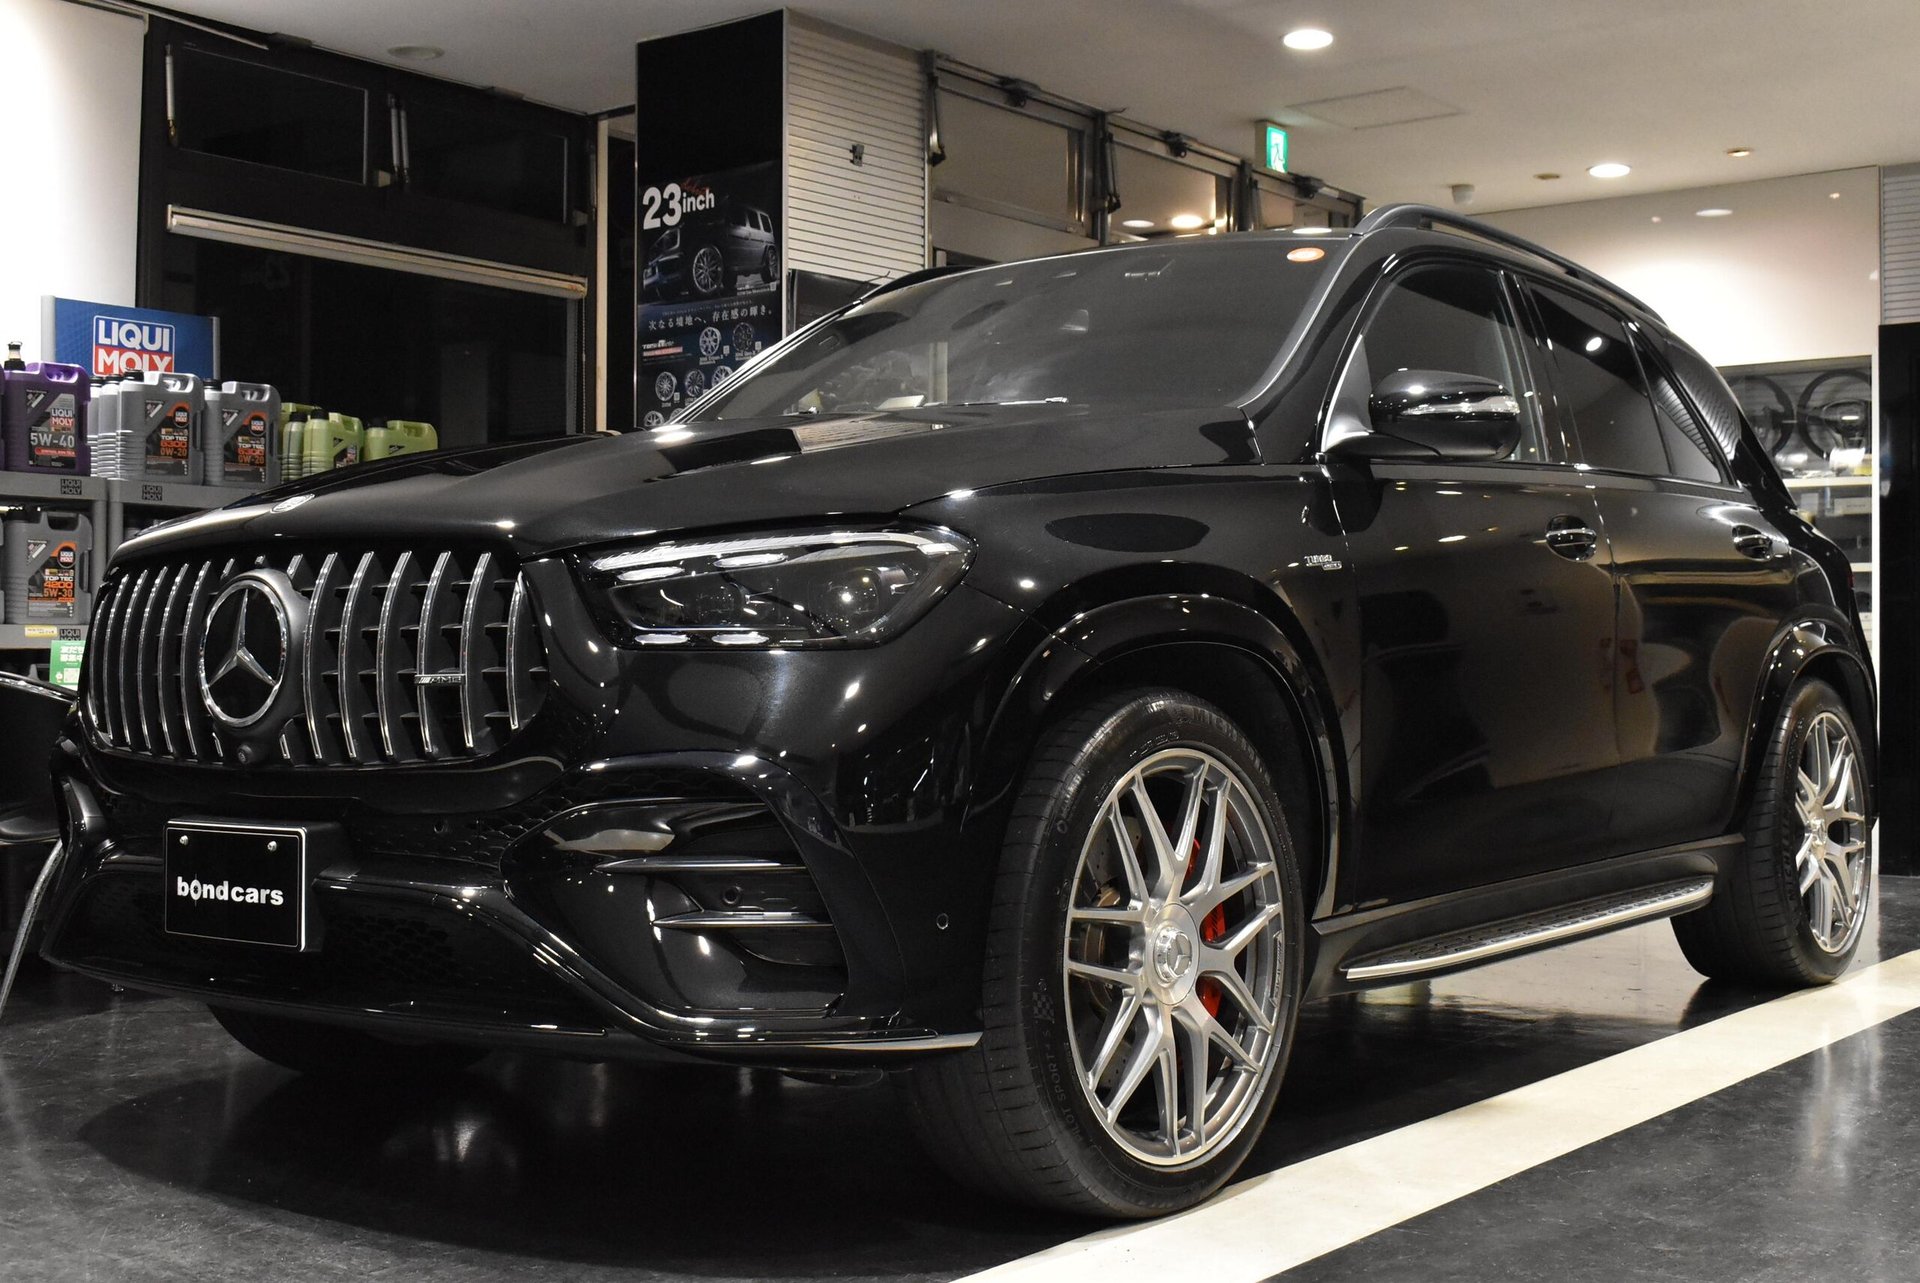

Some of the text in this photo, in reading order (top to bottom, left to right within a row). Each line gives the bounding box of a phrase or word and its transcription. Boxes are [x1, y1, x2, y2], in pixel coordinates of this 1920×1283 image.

[98, 319, 170, 352] LIQUI
[97, 348, 172, 375] MOLY
[51, 408, 73, 417] LIQUI
[51, 418, 74, 426] MOLY
[30, 432, 75, 448] 5W-40
[160, 447, 188, 457] 0W-20
[44, 581, 73, 589] 4200
[43, 588, 73, 598] 5W-30
[1046, 1053, 1067, 1101] SPORT
